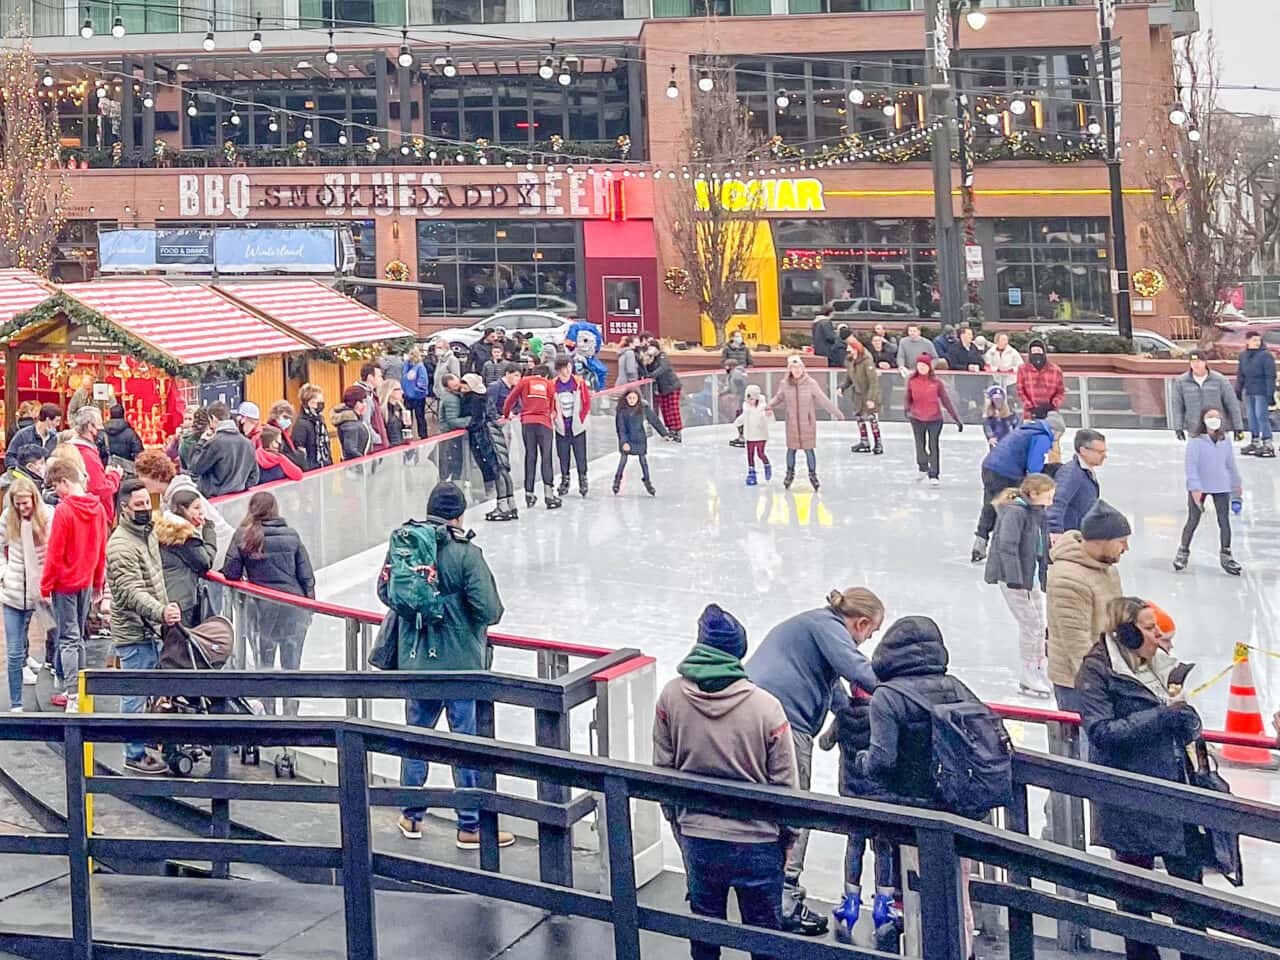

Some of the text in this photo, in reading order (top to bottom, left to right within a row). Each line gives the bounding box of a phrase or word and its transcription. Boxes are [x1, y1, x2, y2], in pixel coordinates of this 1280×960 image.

[179, 174, 251, 218] BBQ
[264, 184, 389, 208] SMOKE
[417, 184, 532, 208] DADDY
[244, 243, 305, 258] Winterland
